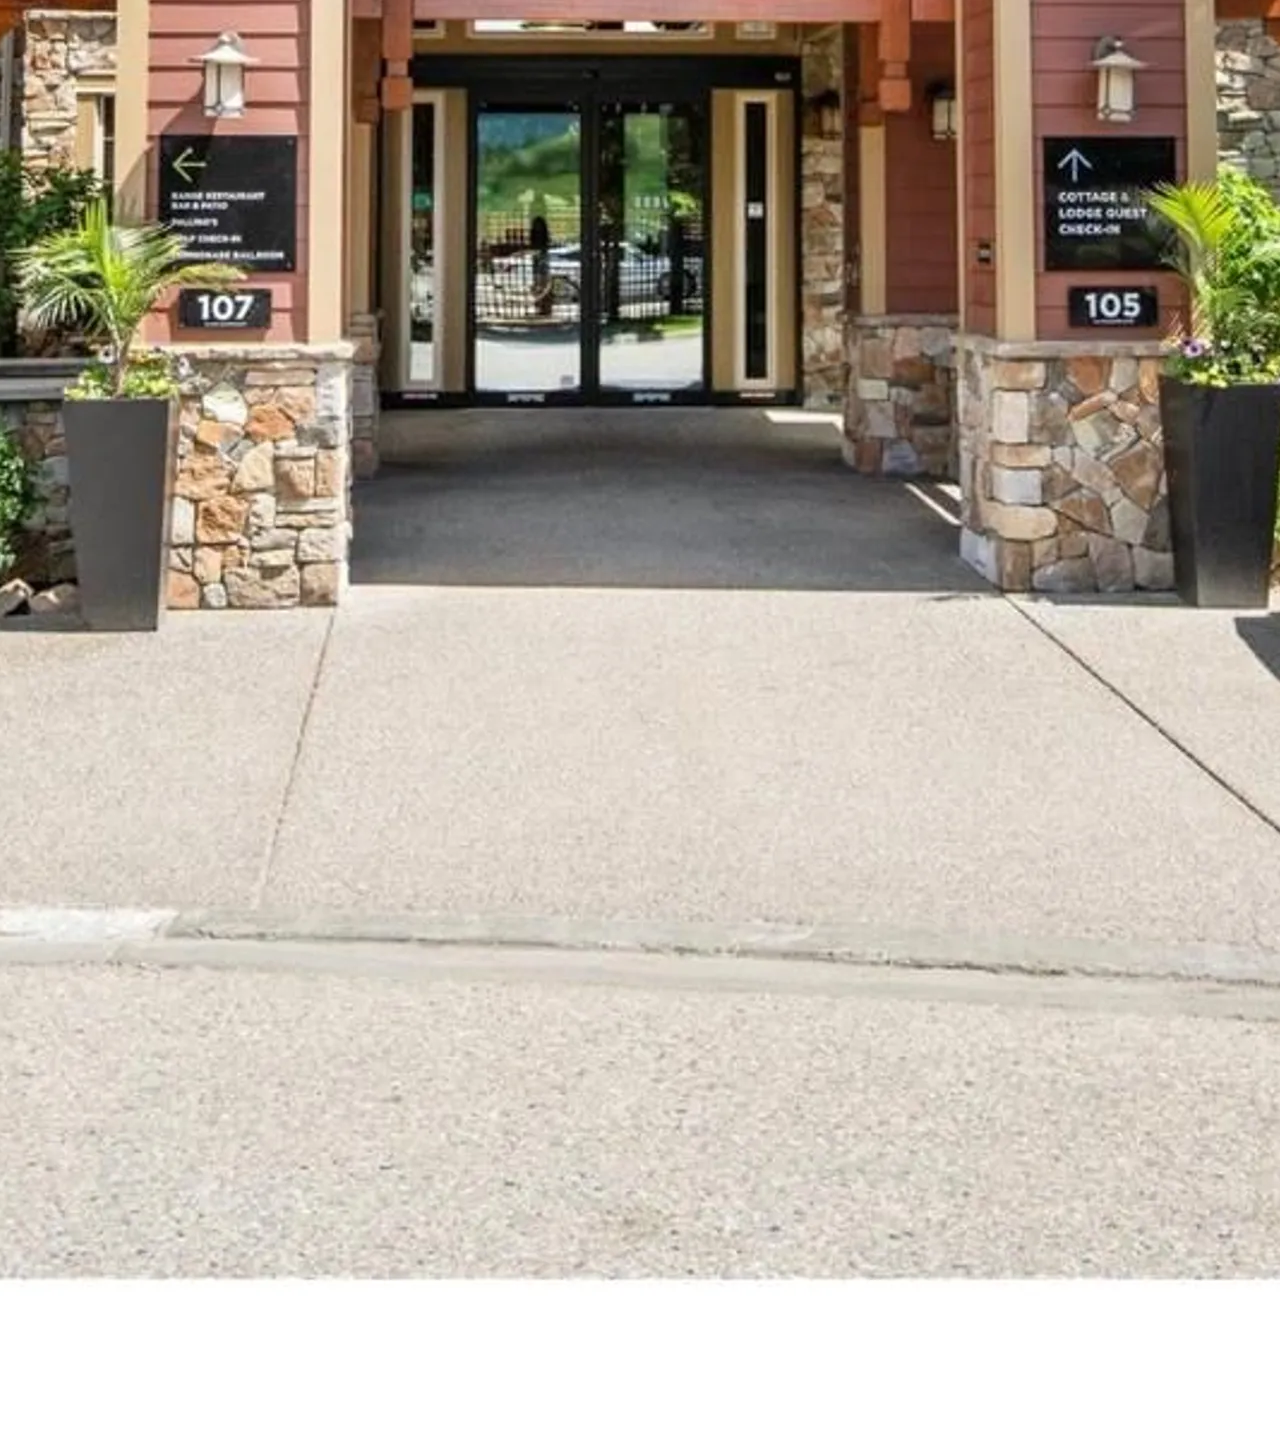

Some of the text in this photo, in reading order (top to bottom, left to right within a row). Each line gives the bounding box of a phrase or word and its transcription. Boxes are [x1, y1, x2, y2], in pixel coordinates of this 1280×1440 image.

[205, 191, 265, 200] RESTAURANT
[1058, 191, 1129, 203] COTTAGE &
[201, 201, 229, 210] PATIO
[1058, 207, 1147, 219] LODGE GUEST
[1058, 223, 1121, 235] CHECK-IN
[197, 294, 254, 320] 107
[1085, 292, 1141, 318] 105
